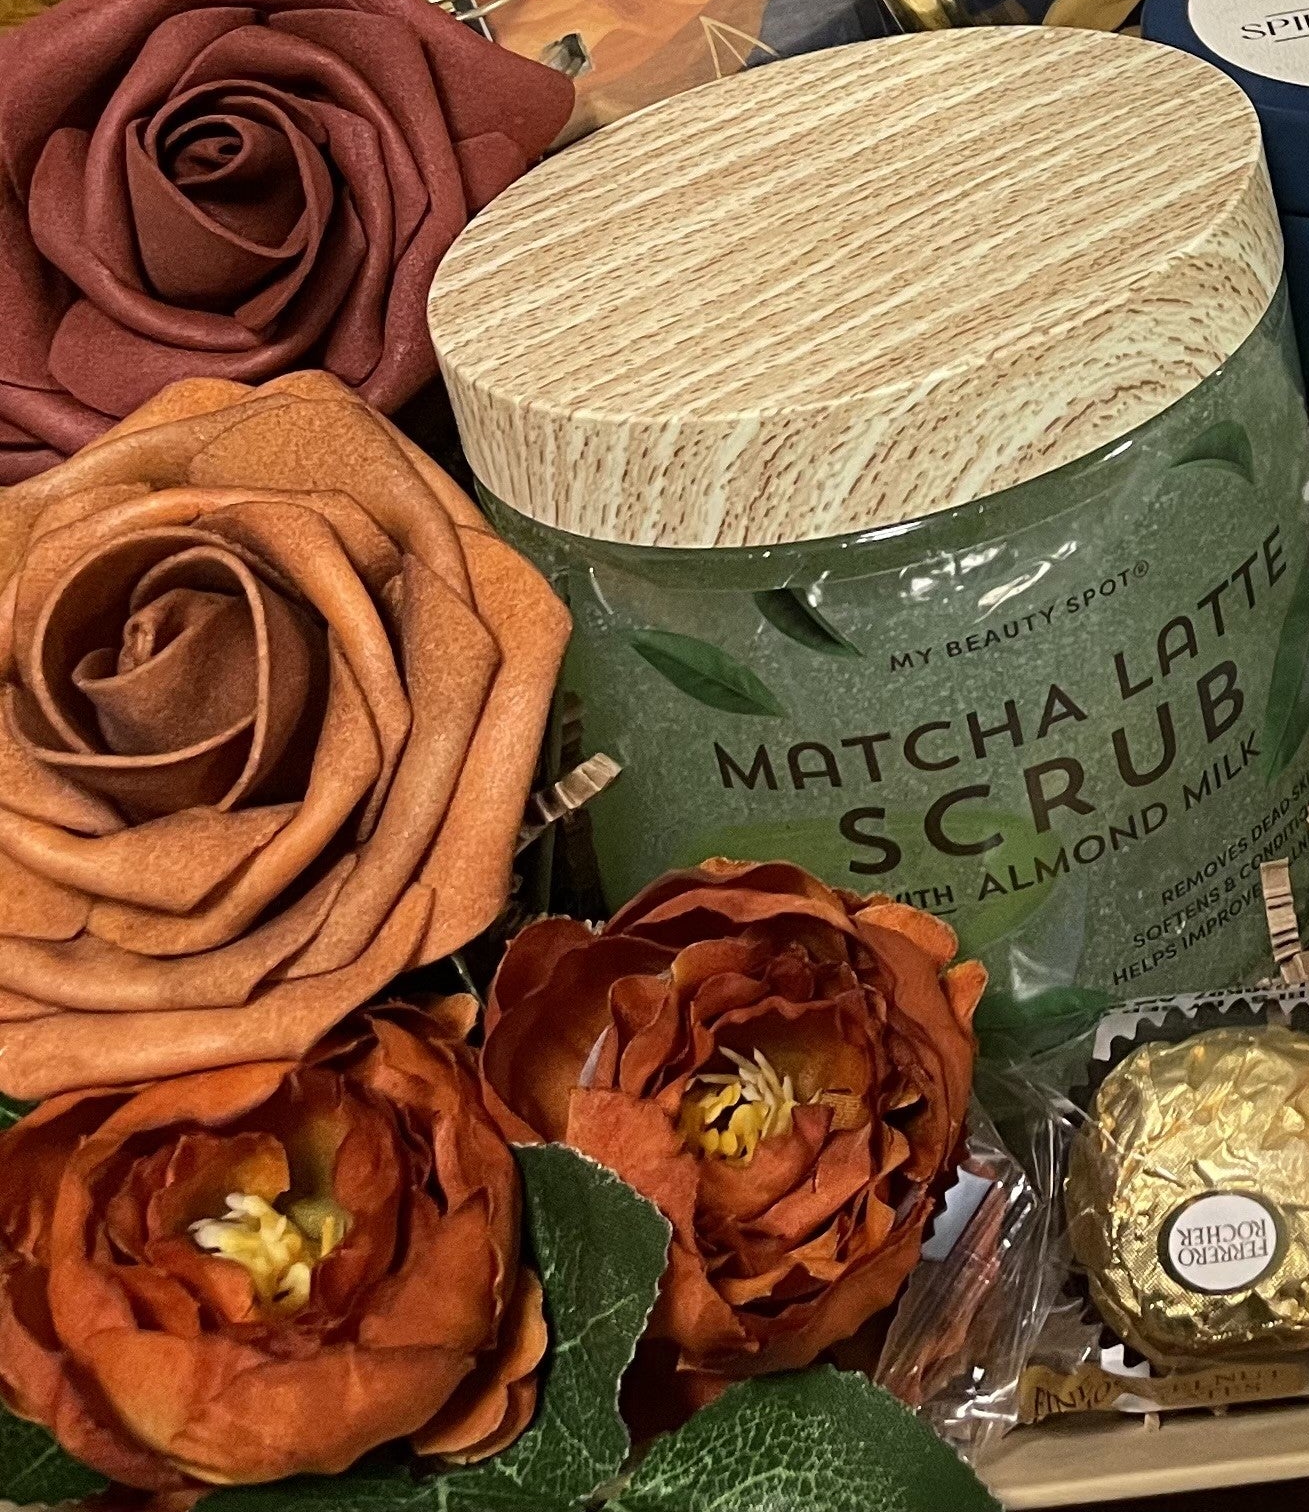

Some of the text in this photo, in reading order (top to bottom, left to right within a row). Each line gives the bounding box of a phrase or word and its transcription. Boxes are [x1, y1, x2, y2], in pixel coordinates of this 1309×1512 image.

[714, 525, 1288, 791] MATCHA LATTE
[890, 647, 932, 673] MY
[946, 605, 1055, 658] BEAUTY
[839, 660, 1246, 876] SCRUB
[896, 730, 1262, 909] ITH ALMOND MILK
[1161, 836, 1248, 907] REMOVES
[1251, 798, 1290, 844] DEAD
[1133, 889, 1220, 949] SOFTENS
[1113, 943, 1177, 986] HELPS
[1176, 1218, 1266, 1247] ROCHER
[1178, 1239, 1269, 1267] FERRERO
